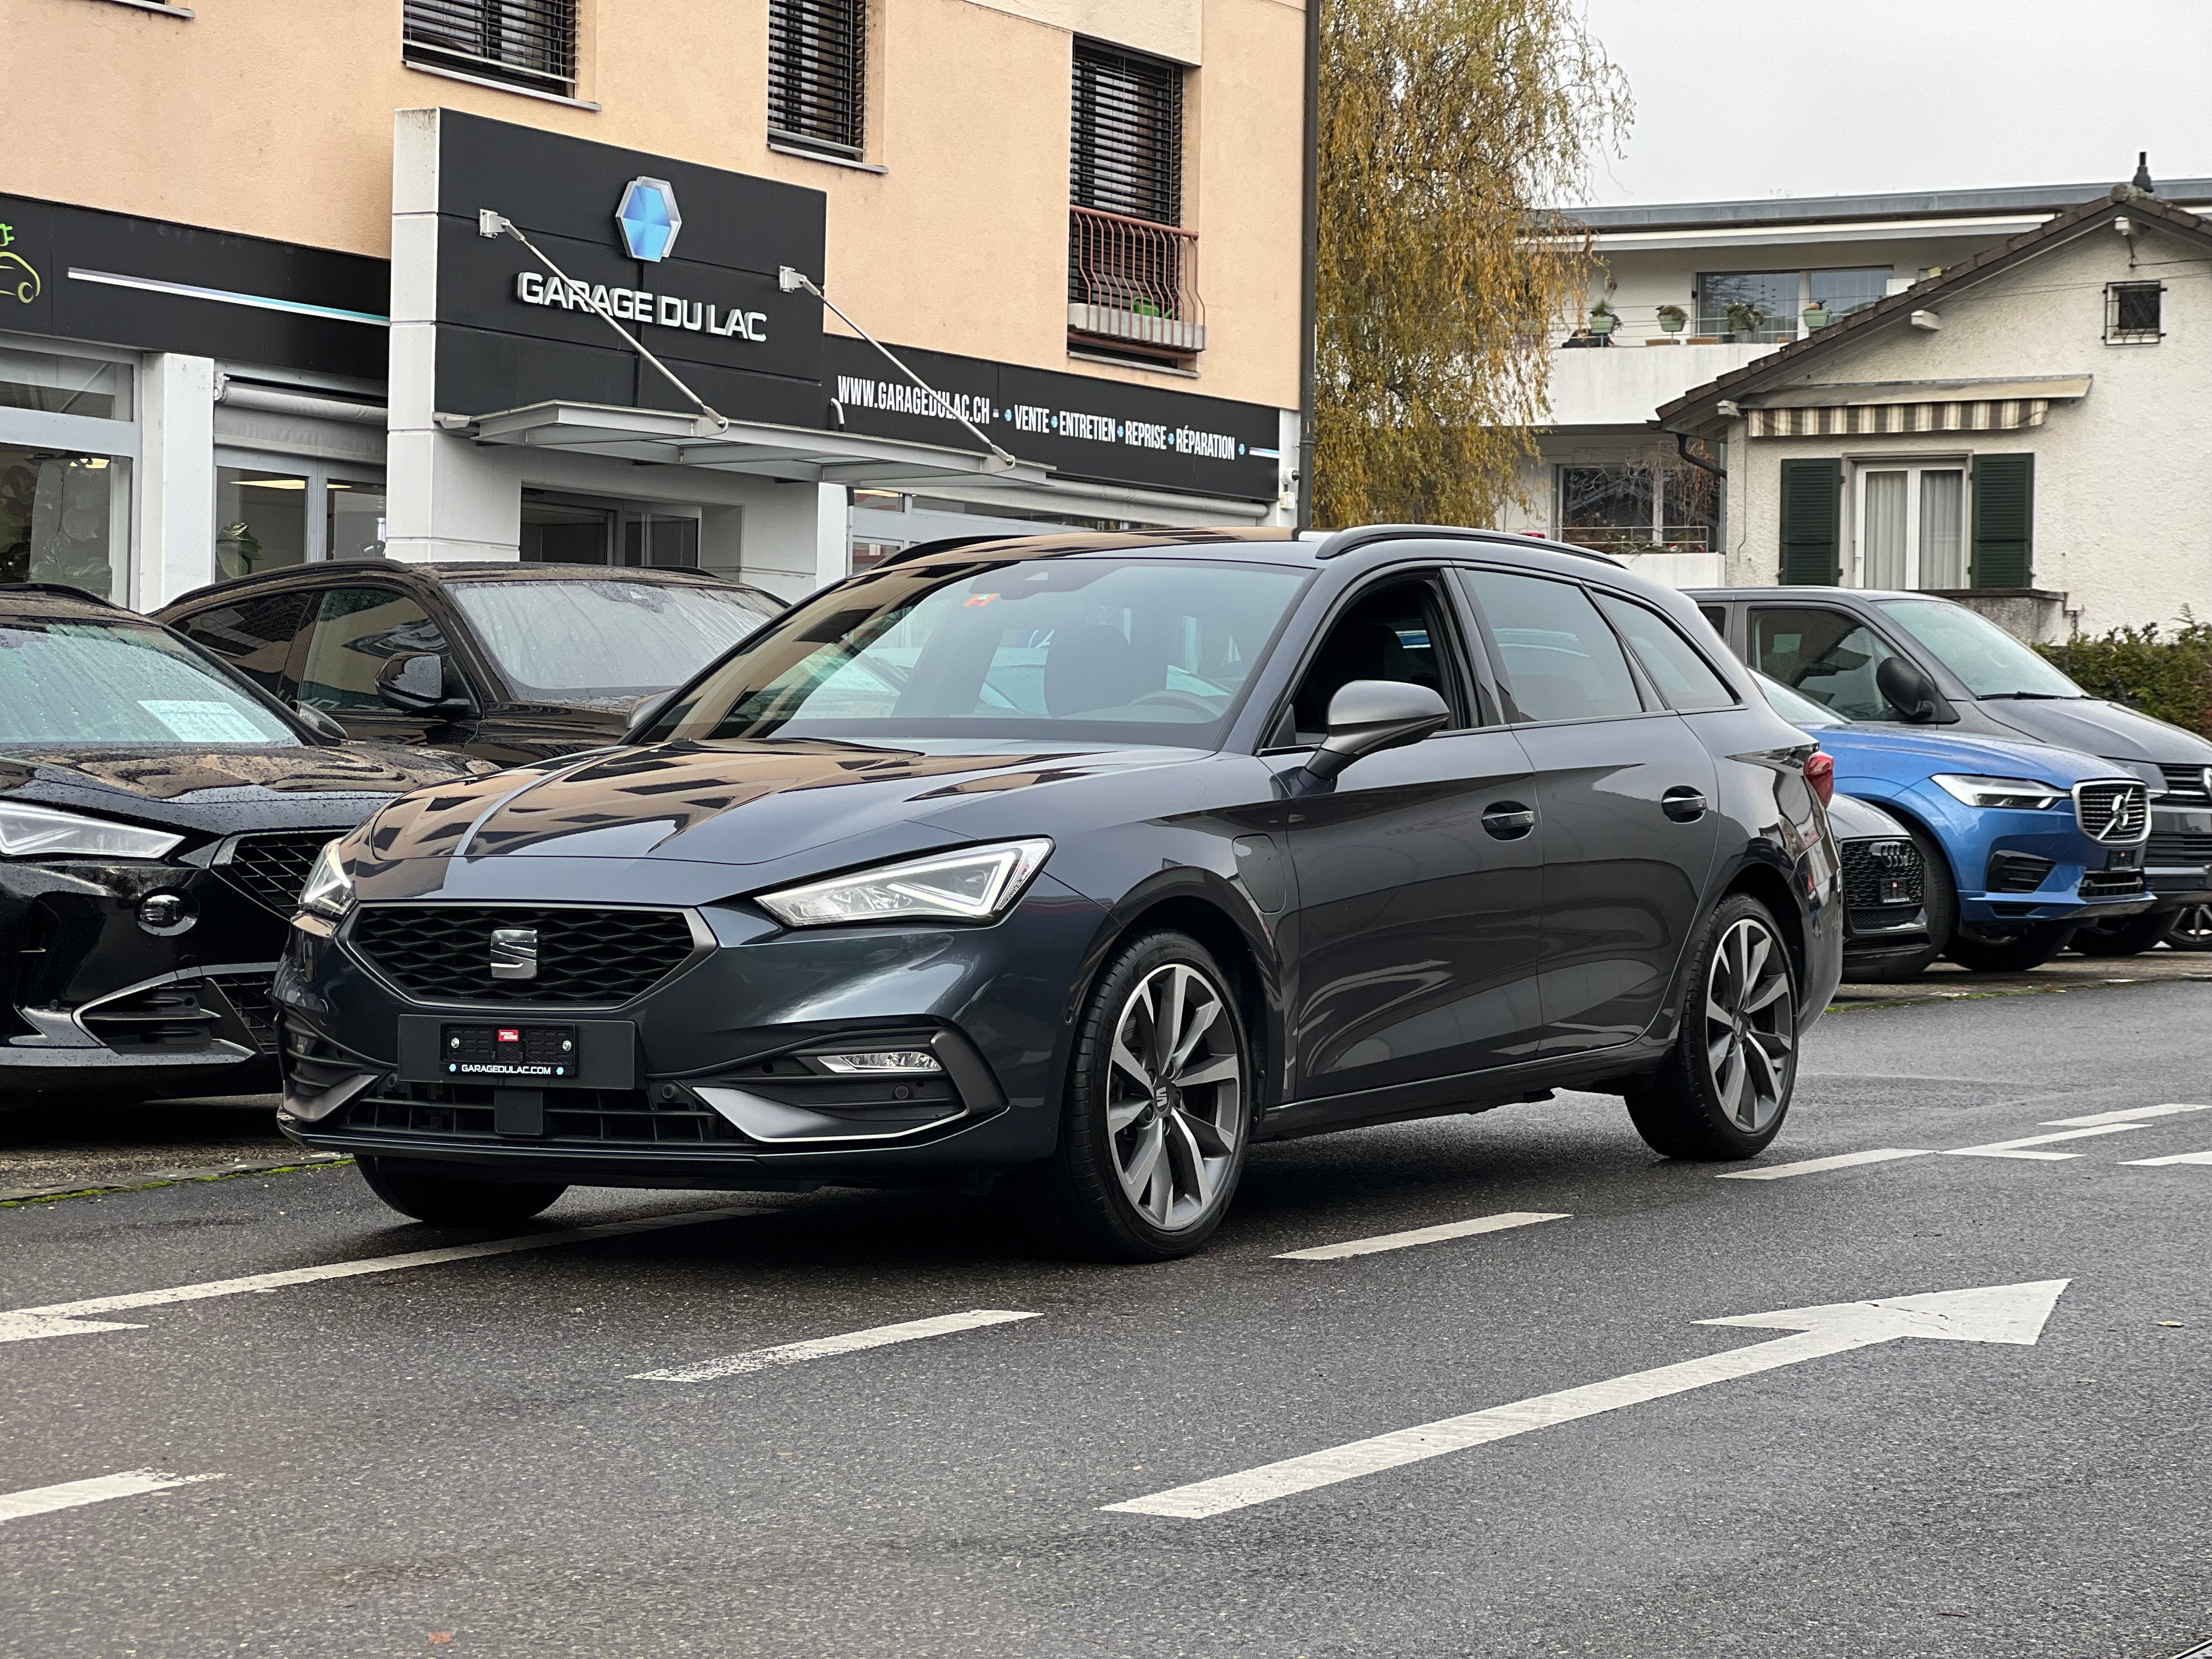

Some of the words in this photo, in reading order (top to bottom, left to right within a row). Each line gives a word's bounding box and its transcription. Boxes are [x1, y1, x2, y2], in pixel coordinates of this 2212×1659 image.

[518, 272, 653, 323] GARAGE
[656, 295, 702, 331] DU
[706, 304, 767, 341] LAC
[838, 375, 990, 424] WWW.GARAGEDULAC.CH
[1014, 404, 1049, 433] VENTE
[1059, 411, 1116, 442] ENTRETIEN
[1125, 420, 1167, 450] REPRISE
[1176, 425, 1235, 460] RÉPARATION
[461, 1064, 551, 1075] GARAGEDULAC.COM
